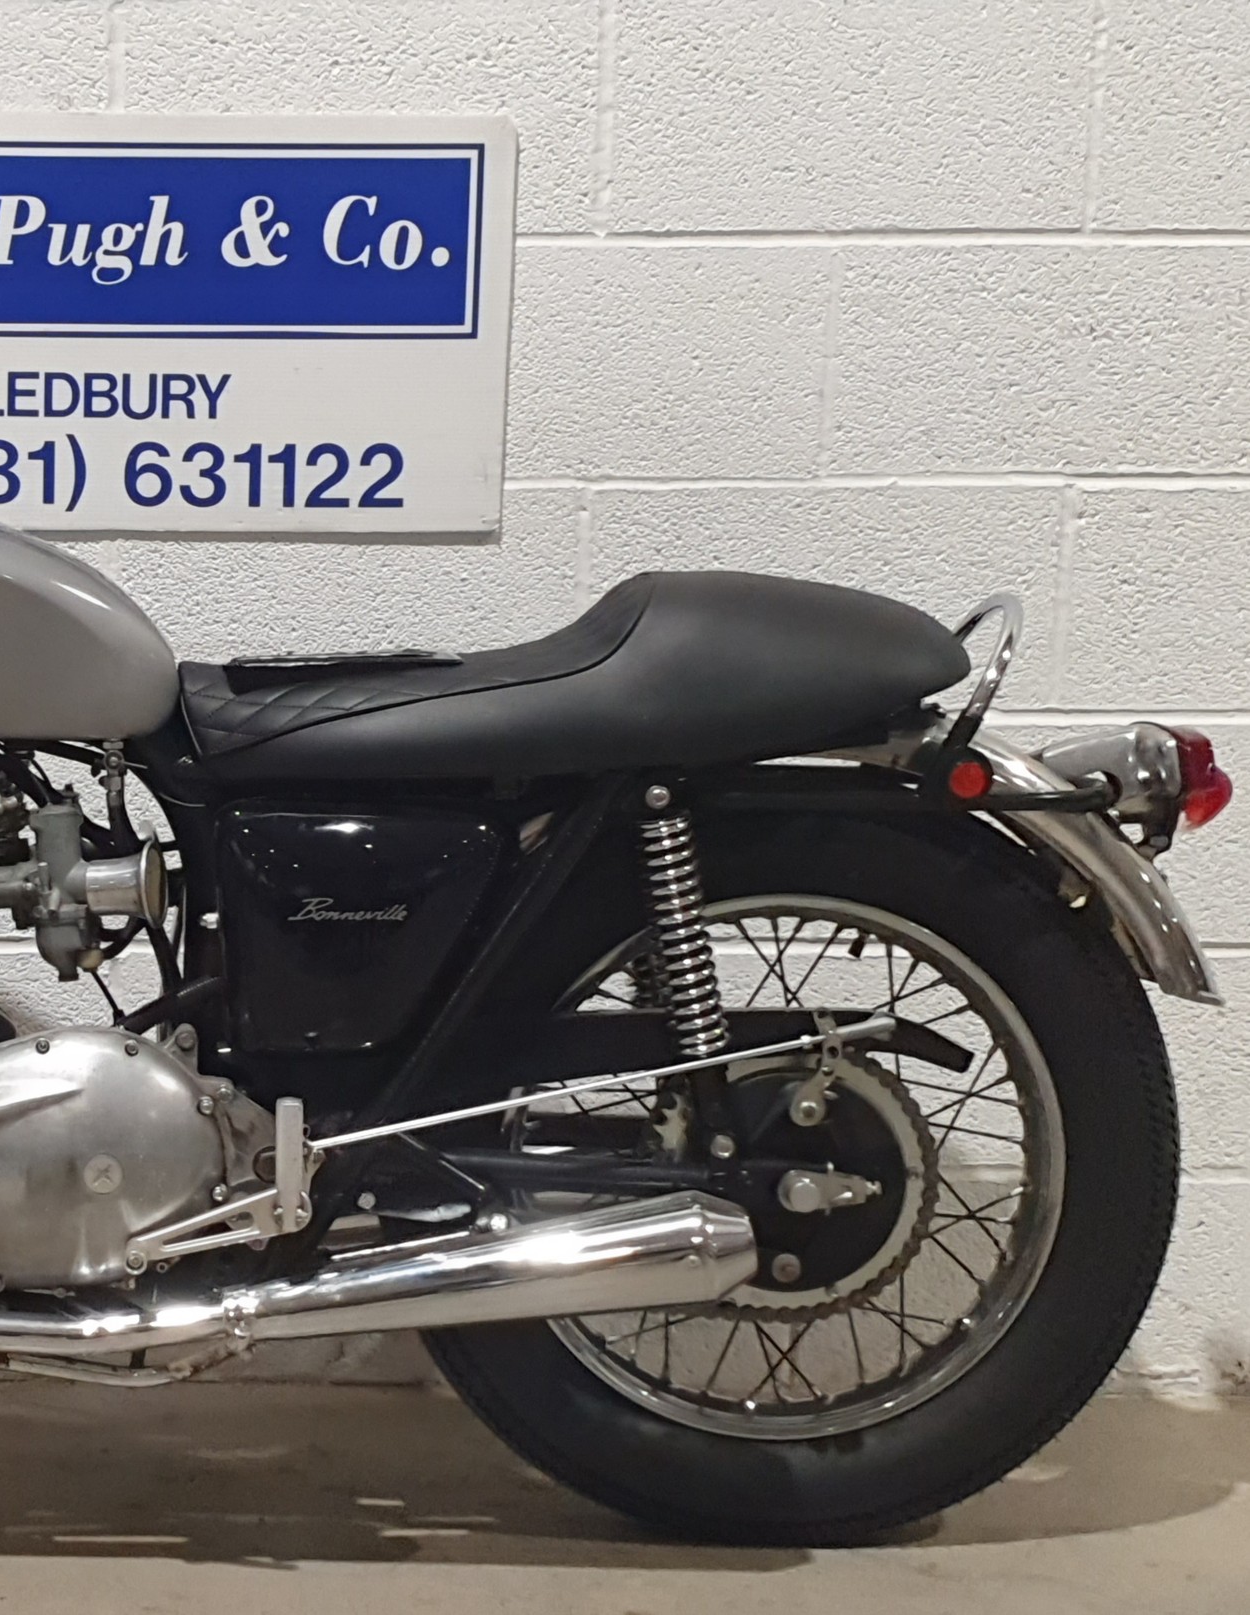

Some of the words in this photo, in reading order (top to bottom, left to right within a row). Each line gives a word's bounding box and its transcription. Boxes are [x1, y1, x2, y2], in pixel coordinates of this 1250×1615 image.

[220, 195, 290, 268] &
[323, 195, 451, 270] Co.
[124, 440, 405, 509] 631122
[287, 897, 407, 921] Bonneville
